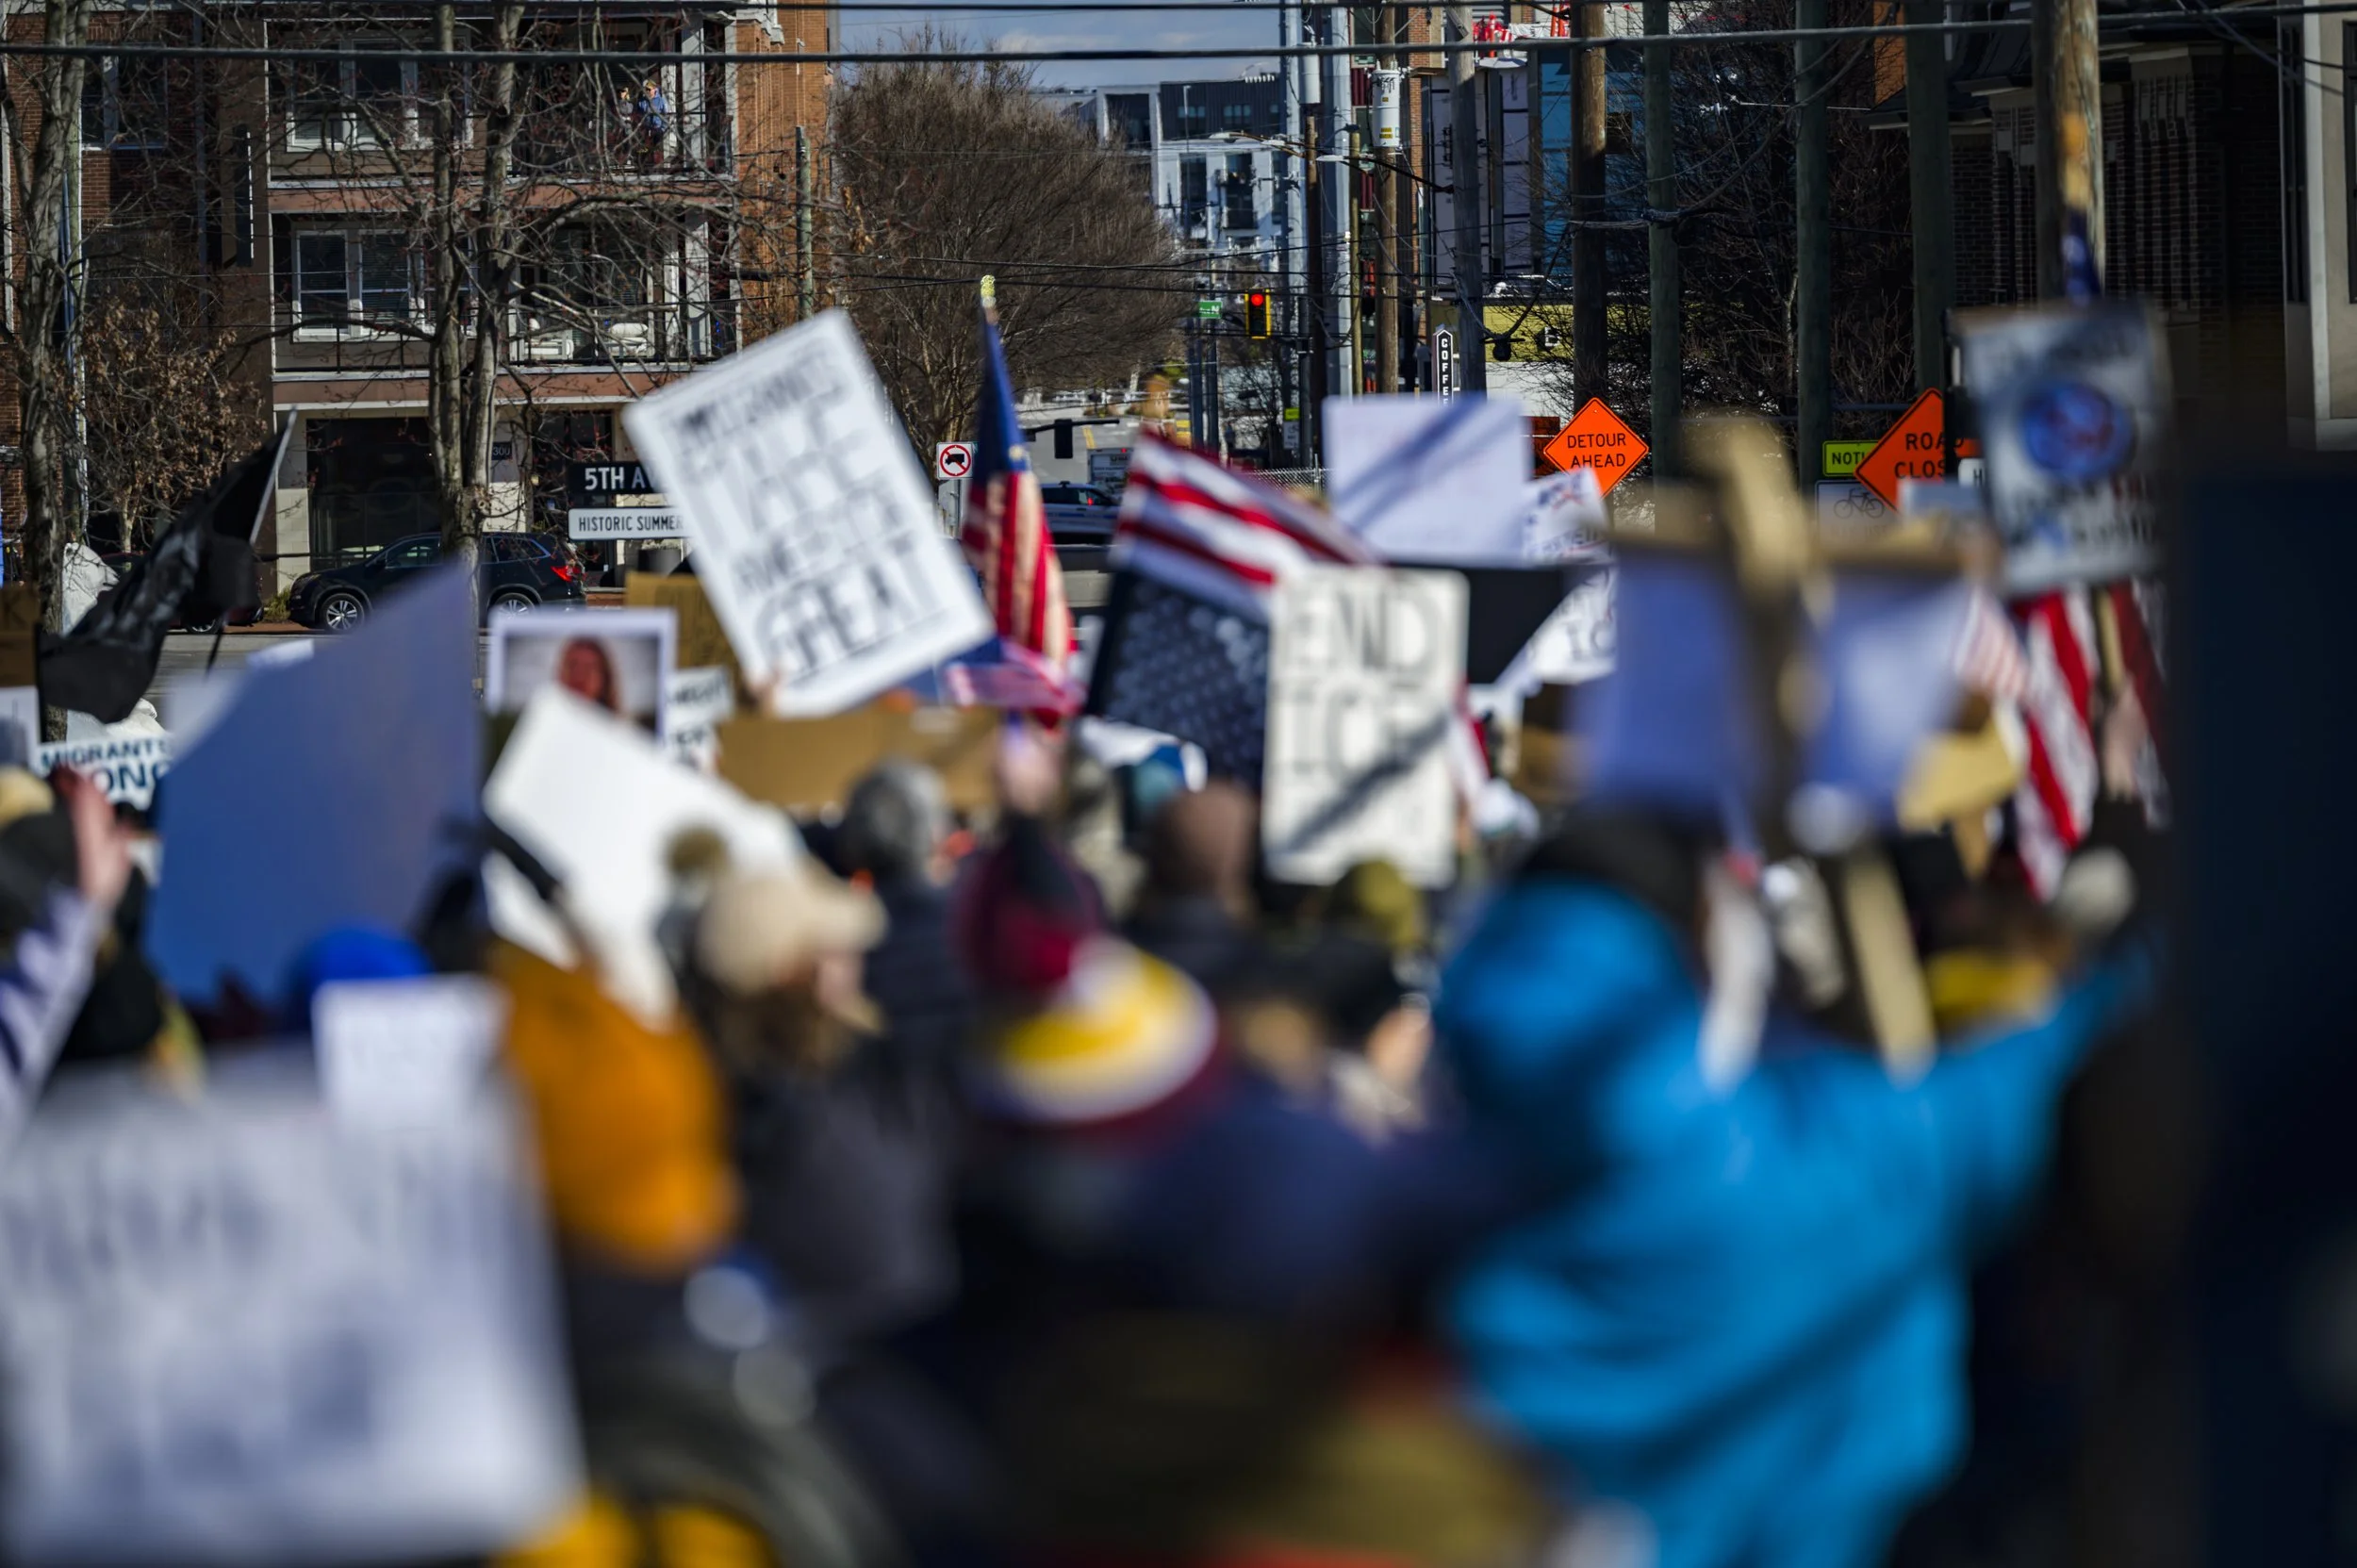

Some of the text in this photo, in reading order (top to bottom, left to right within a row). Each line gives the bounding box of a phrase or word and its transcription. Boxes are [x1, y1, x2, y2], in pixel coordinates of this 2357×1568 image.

[1567, 433, 1626, 449] DETOUR
[1571, 454, 1626, 469] AHEAD
[585, 467, 624, 490] 5TH
[579, 517, 633, 532] HISTORIC
[1278, 583, 1434, 675] END
